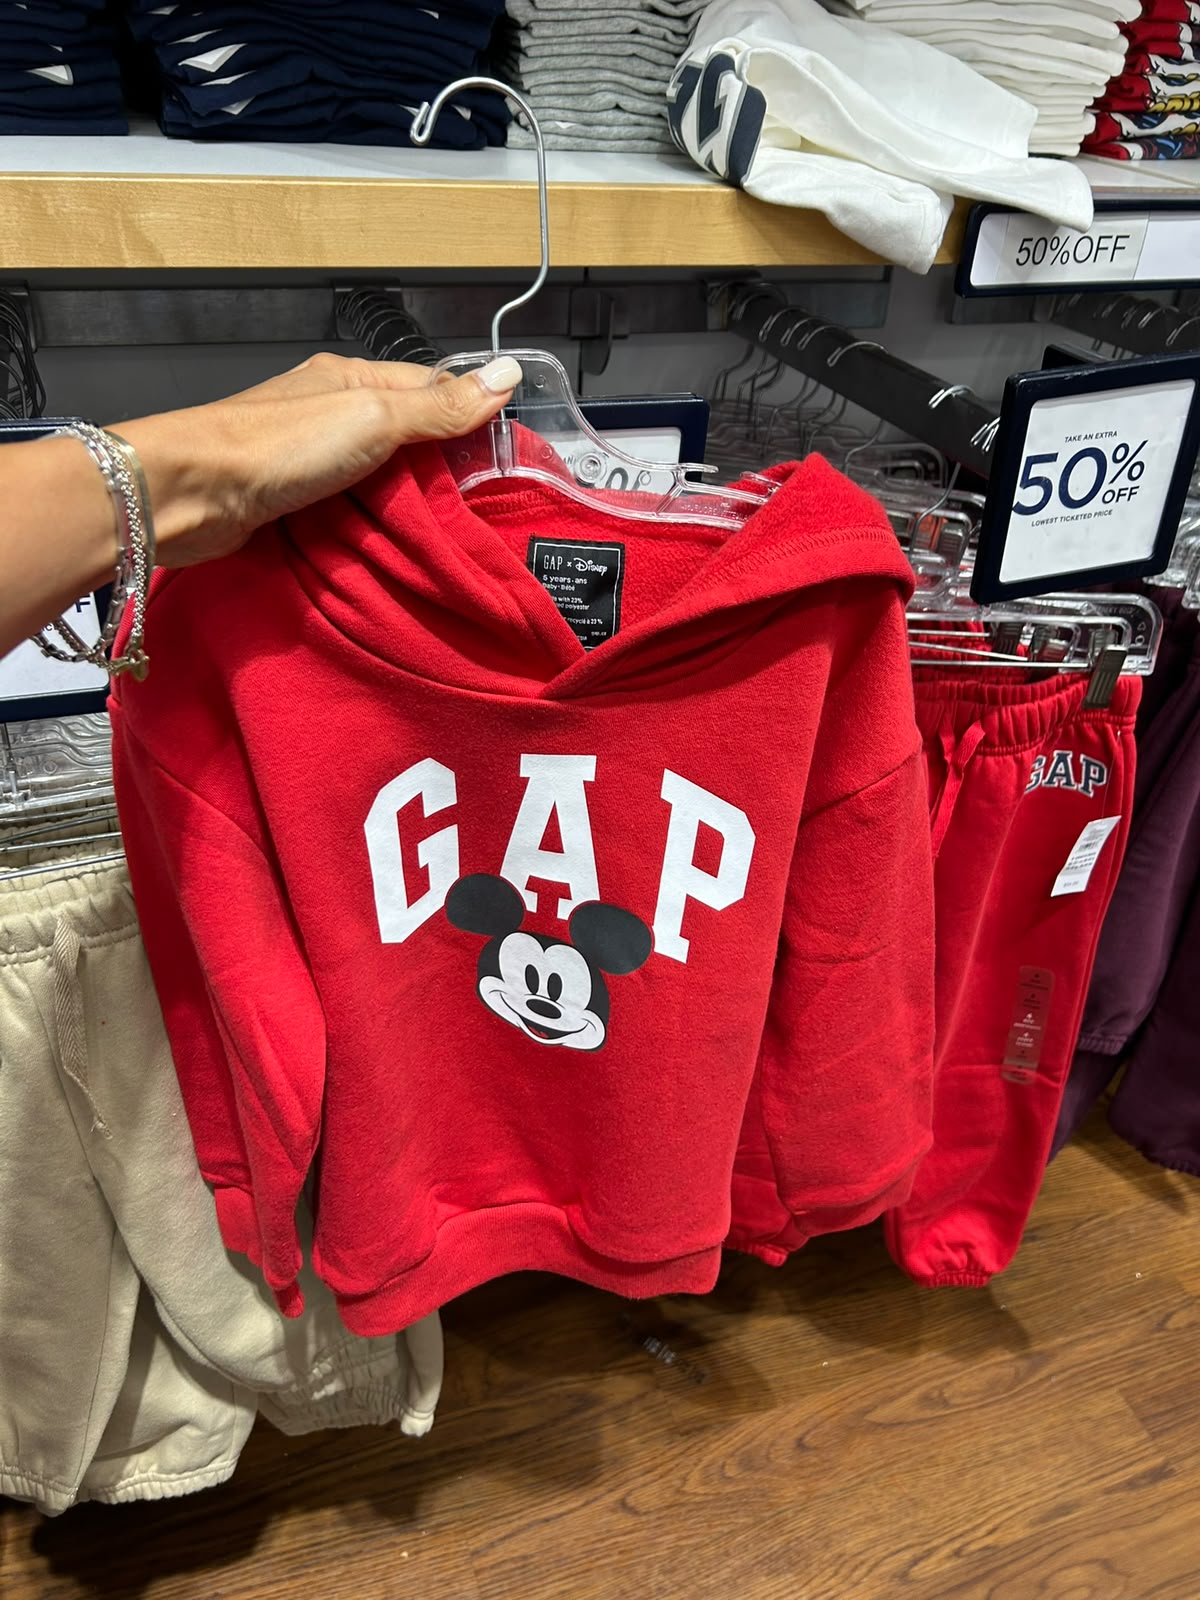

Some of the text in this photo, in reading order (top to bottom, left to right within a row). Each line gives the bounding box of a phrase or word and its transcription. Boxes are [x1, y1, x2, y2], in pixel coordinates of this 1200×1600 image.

[1064, 431, 1118, 443] TAKE AN EXTRA
[1102, 485, 1140, 505] OFF
[1031, 509, 1113, 527] LOWEST TICKETED PRICE
[543, 554, 563, 571] GAP
[1024, 750, 1107, 798] GAP
[364, 753, 756, 964] GAP
